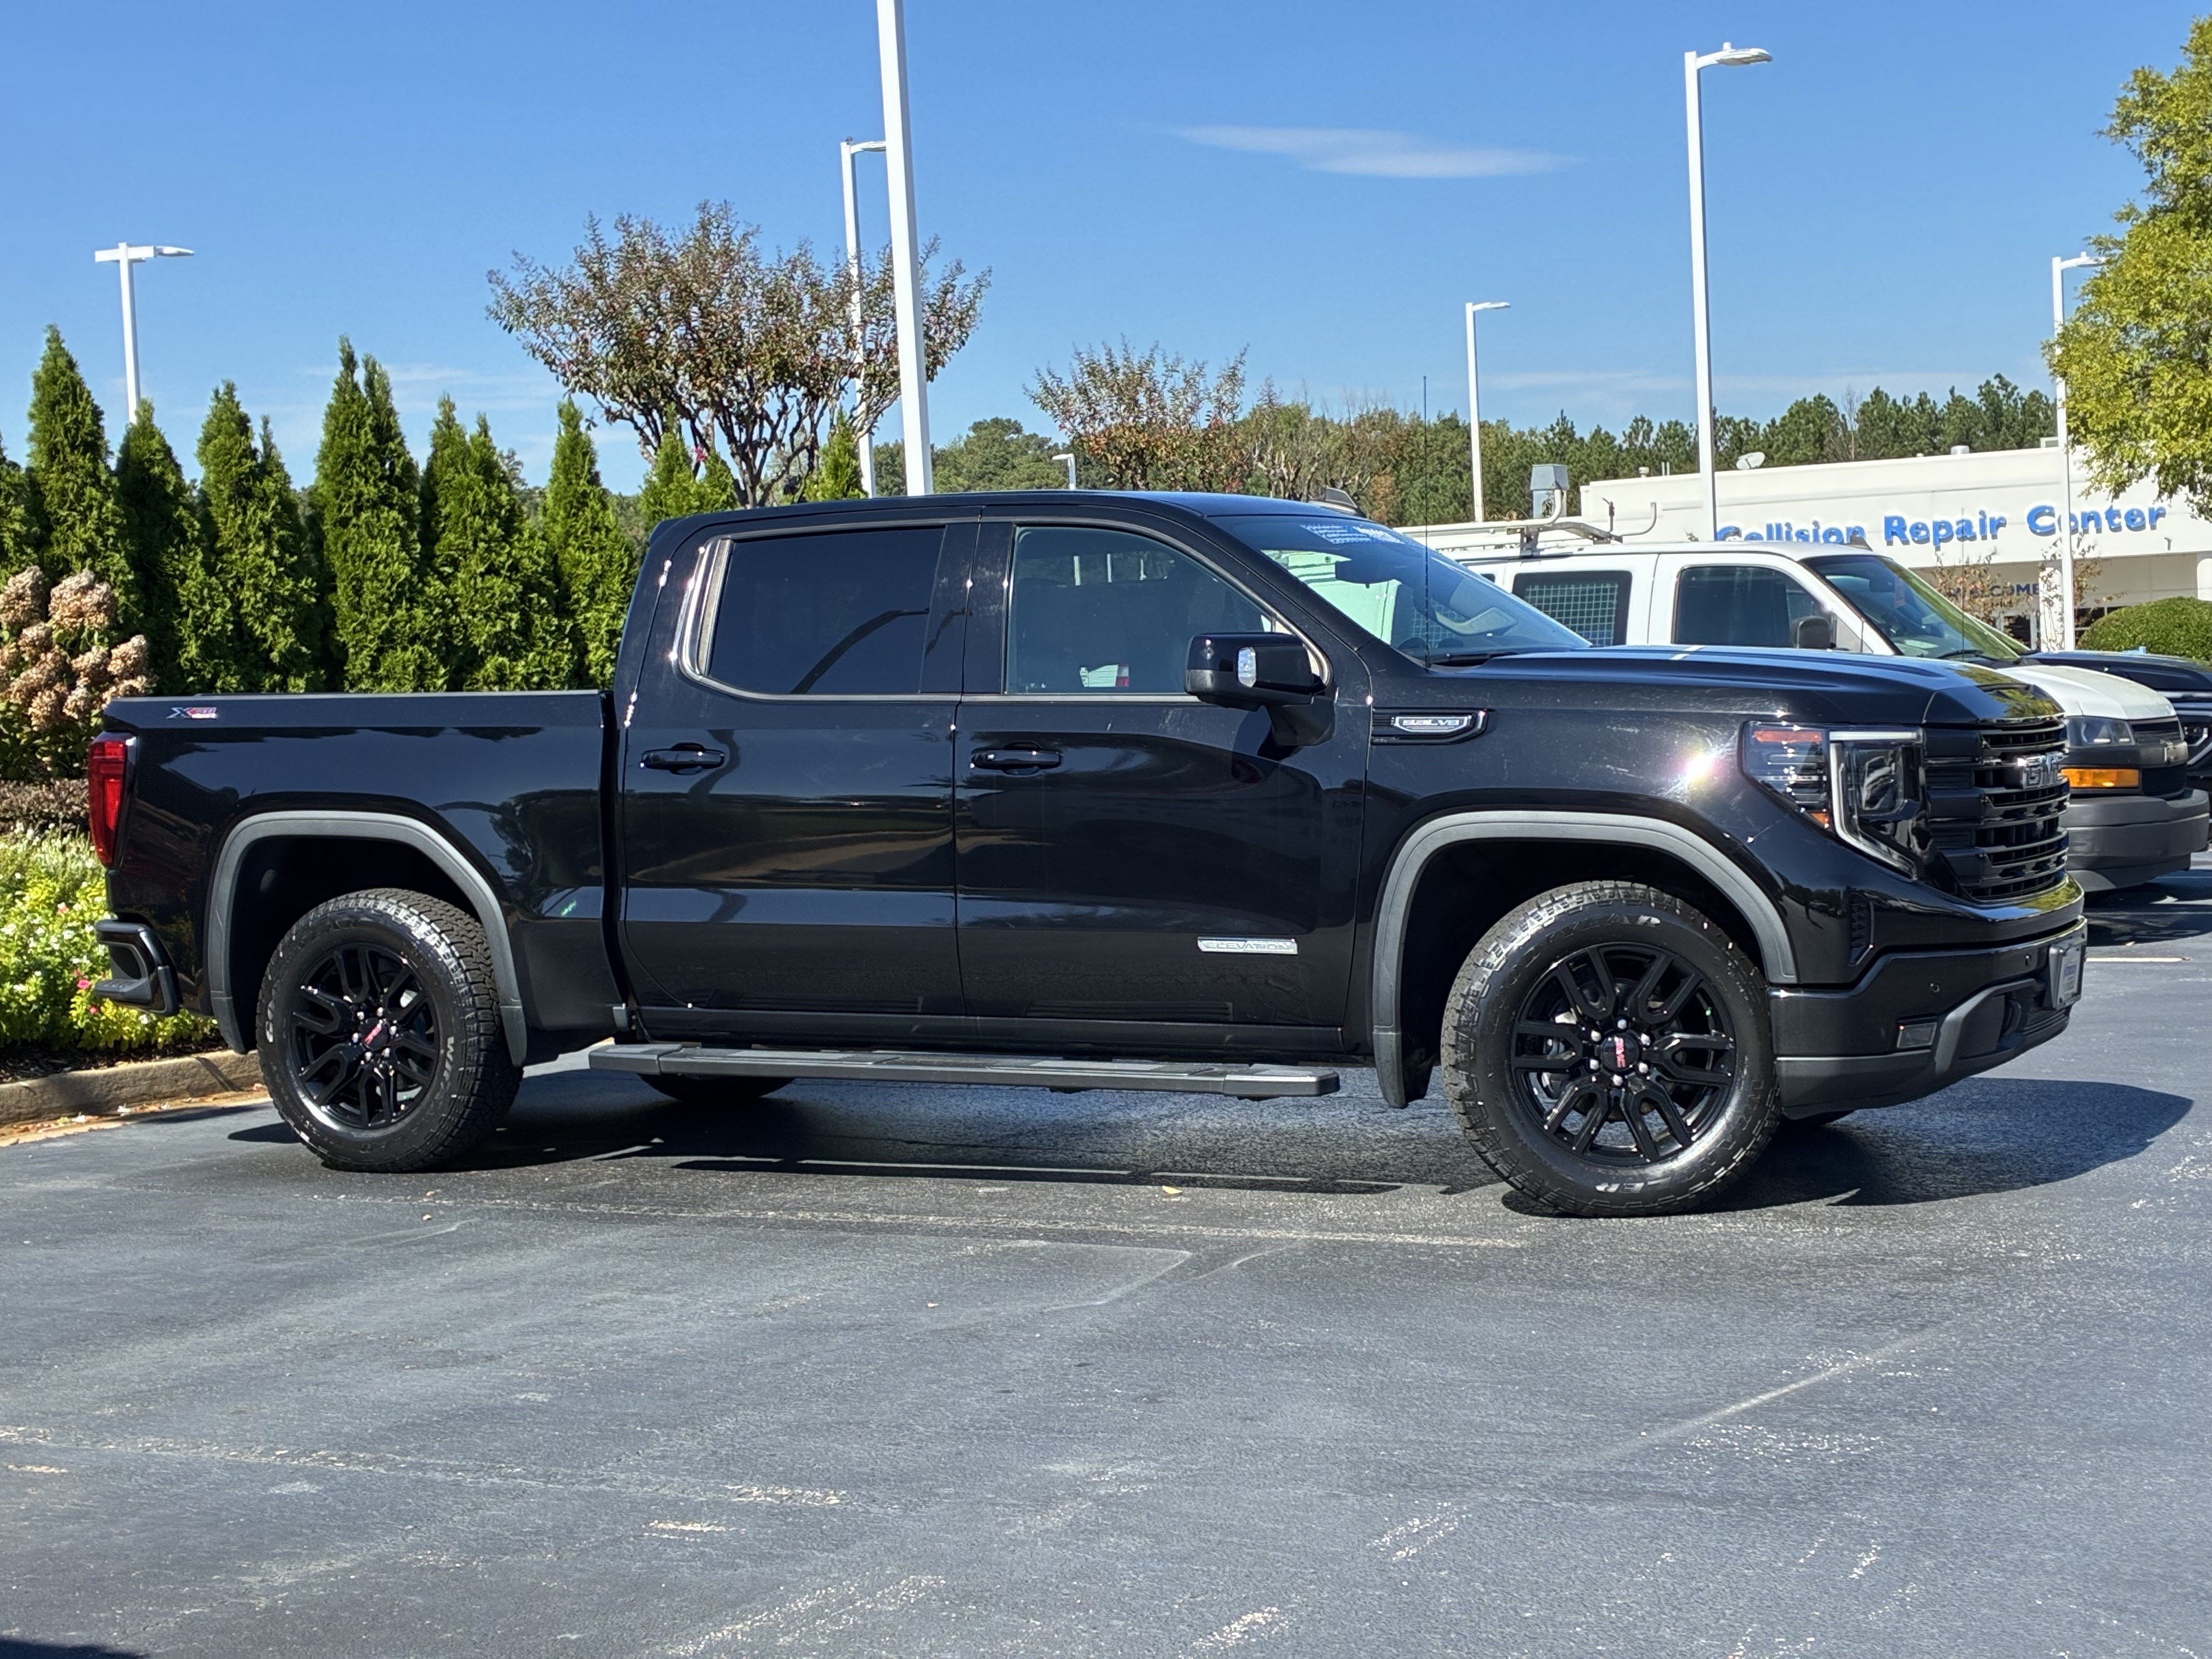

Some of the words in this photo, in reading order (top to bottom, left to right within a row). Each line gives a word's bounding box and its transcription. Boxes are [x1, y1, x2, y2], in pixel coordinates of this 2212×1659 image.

[1883, 509, 2007, 551] Repair
[2026, 504, 2167, 537] Center
[1205, 941, 1293, 951] ELEVATION
